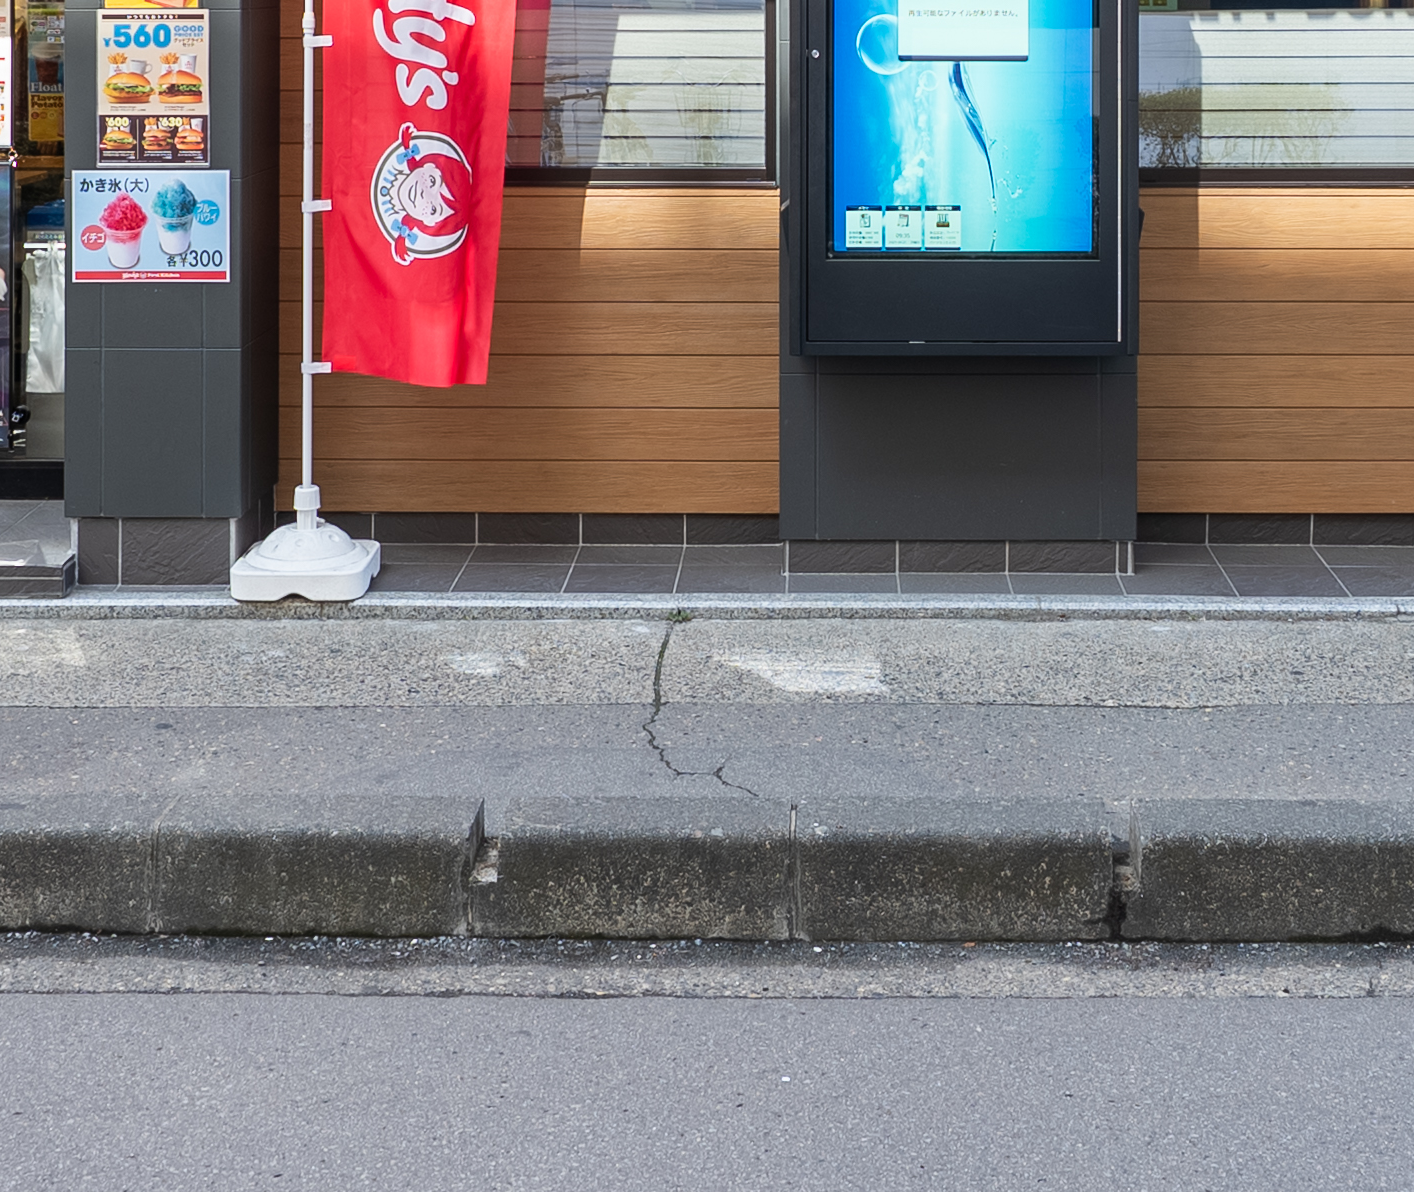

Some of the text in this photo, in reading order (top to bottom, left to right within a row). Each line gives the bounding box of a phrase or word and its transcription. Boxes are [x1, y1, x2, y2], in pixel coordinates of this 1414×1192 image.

[174, 25, 205, 33] GOOD
[103, 23, 172, 49] ¥560
[31, 83, 62, 92] Float
[79, 177, 150, 193] かき氷(大)
[196, 203, 218, 213] ブルー
[196, 212, 218, 222] ハワイ
[81, 232, 106, 243] イチゴ
